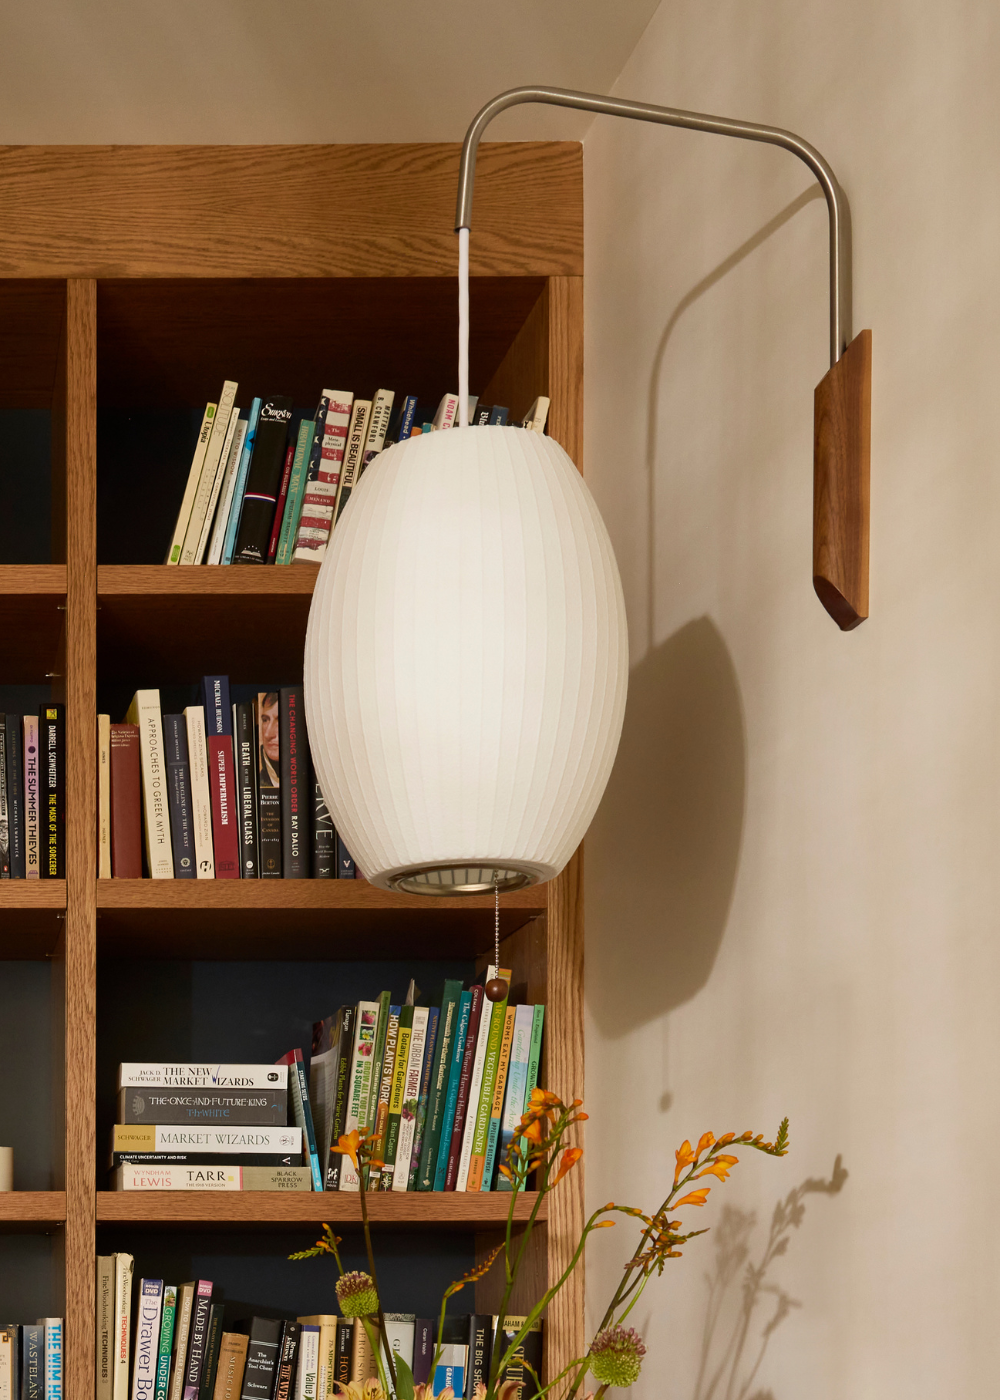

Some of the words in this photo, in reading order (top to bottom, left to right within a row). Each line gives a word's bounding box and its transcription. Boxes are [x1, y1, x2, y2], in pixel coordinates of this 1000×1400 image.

[353, 408, 365, 432] SMALL
[444, 399, 456, 420] NOAM
[344, 444, 358, 485] BEAUTIFUL
[214, 680, 222, 707] MICHAEL
[215, 709, 223, 733] HUDSON
[148, 718, 160, 773] APPROACHES
[153, 777, 160, 788] TO
[153, 791, 162, 818] GREEK
[219, 773, 228, 825] IMPERIALISM
[182, 808, 187, 817] OF
[156, 821, 165, 844] MYTH
[388, 1015, 399, 1038] HOW
[414, 1029, 424, 1042] THE
[503, 1015, 512, 1040] WORMS
[399, 1033, 408, 1061] Botany
[466, 1035, 474, 1048] The
[384, 1039, 396, 1076] PLANTS
[411, 1044, 423, 1067] URBAN
[462, 1051, 472, 1073] Winter
[163, 1067, 184, 1076] THE
[188, 1068, 212, 1076] NEW
[163, 1078, 207, 1086] MARKET
[212, 1072, 254, 1086] WIZARDS
[372, 1062, 381, 1093] Container
[500, 1062, 506, 1075] MY
[352, 1078, 362, 1101] SQUARE
[380, 1078, 391, 1105] WORK
[393, 1071, 404, 1109] Gardeners
[407, 1069, 419, 1097] FARMER
[458, 1074, 468, 1099] Harvest
[494, 1080, 504, 1111] GARBAGE
[351, 1102, 359, 1118] FEET
[454, 1101, 465, 1133] Handbook
[161, 1134, 211, 1144] MARKET
[215, 1134, 269, 1145] WIZARDS
[333, 1118, 341, 1139] Gardens
[387, 1138, 395, 1157] Capon
[134, 1178, 171, 1186] LEWIS
[187, 1171, 225, 1181] TARR
[183, 1313, 189, 1322] TO
[195, 1299, 208, 1331] MADE
[48, 1324, 61, 1349] THE
[138, 1306, 158, 1373] Drawer
[162, 1308, 172, 1353] GROWING
[194, 1334, 203, 1347] BY
[48, 1353, 61, 1380] WIM
[159, 1356, 169, 1388] UNDER
[189, 1349, 201, 1382] HAND
[227, 1357, 235, 1385] MUSIC
[174, 1368, 182, 1400] FURNITURE
